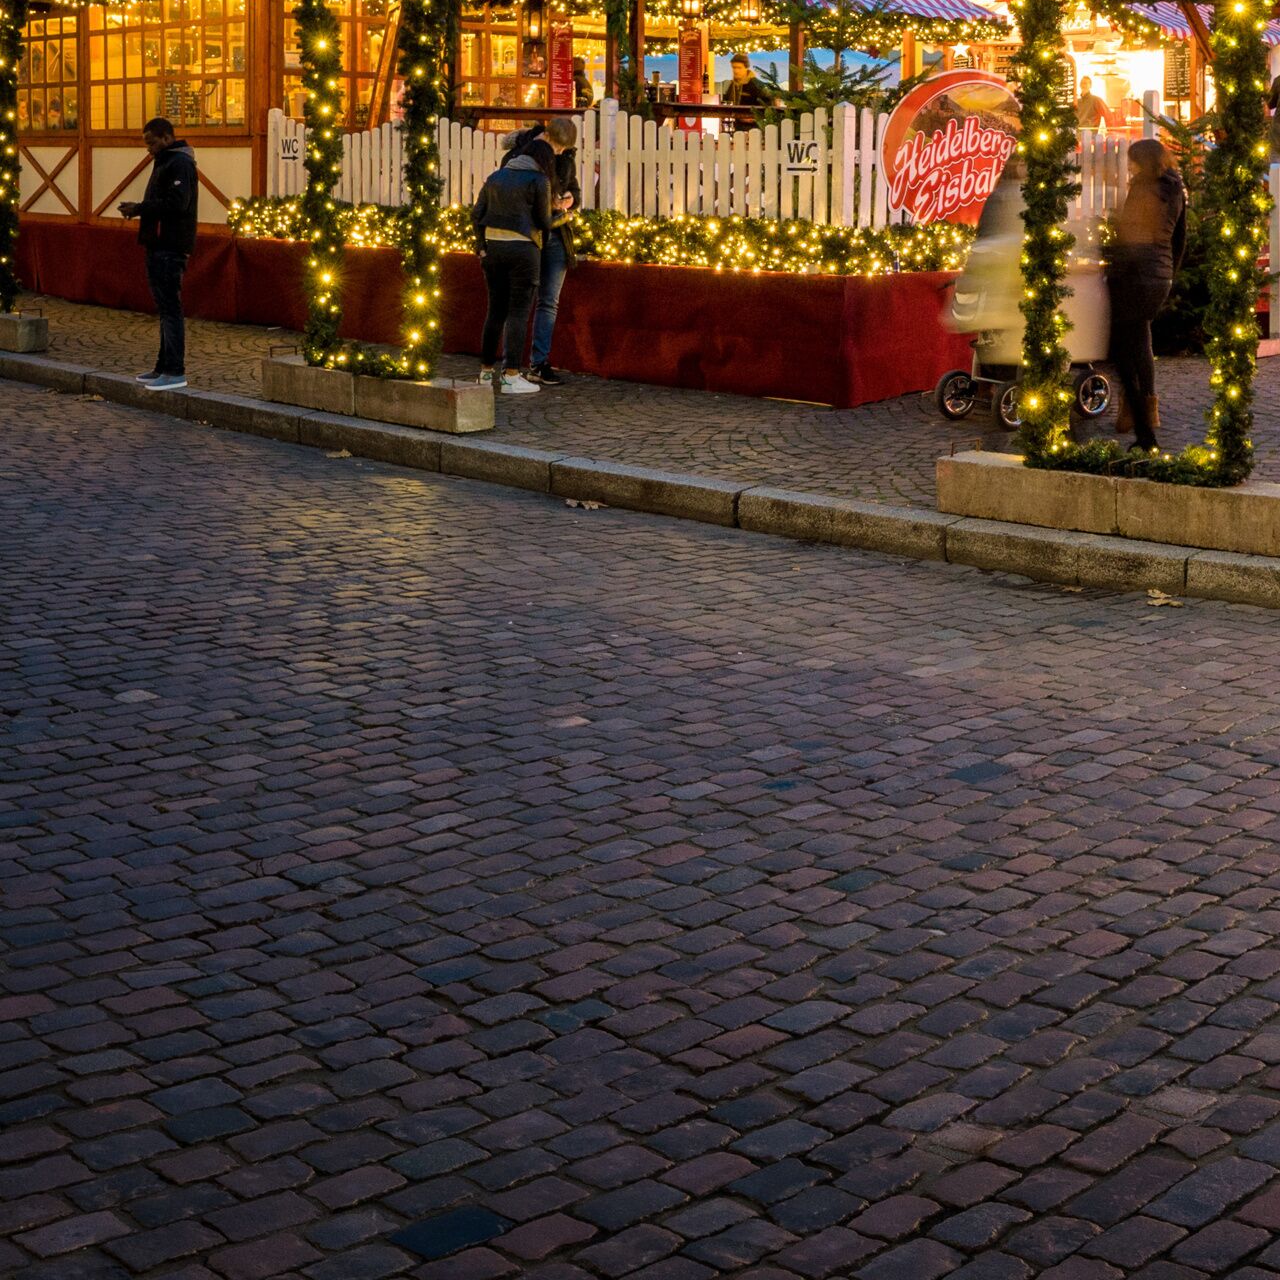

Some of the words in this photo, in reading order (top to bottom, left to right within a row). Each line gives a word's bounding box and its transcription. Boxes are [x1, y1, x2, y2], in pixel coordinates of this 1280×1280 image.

[281, 138, 299, 154] WC
[786, 142, 818, 164] WC
[912, 157, 1003, 226] Eisbah
